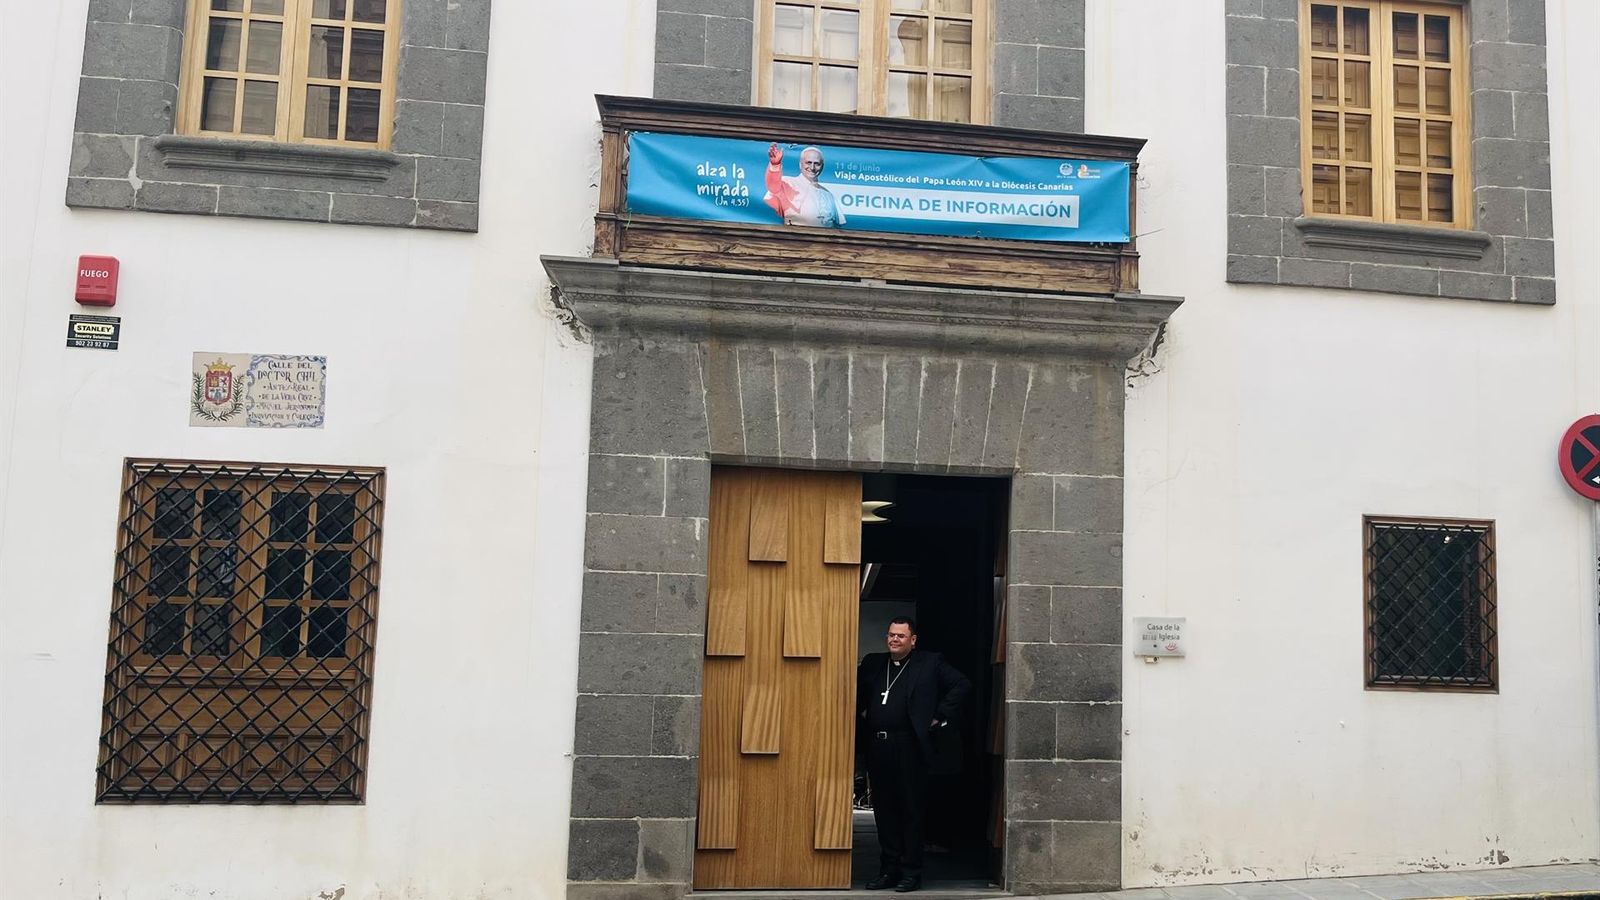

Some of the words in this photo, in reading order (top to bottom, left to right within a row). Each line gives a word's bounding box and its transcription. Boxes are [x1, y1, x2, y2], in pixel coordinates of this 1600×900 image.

[696, 160, 727, 178] alza
[732, 162, 745, 179] la
[835, 162, 844, 170] 11
[847, 162, 857, 171] de
[859, 163, 880, 172] junio
[834, 171, 857, 181] Viaje
[859, 172, 904, 184] Apostólico
[905, 175, 920, 184] del
[923, 177, 944, 187] Papa
[946, 178, 967, 187] León
[968, 179, 983, 188] XIV
[991, 180, 1000, 189] la
[1001, 181, 1036, 190] Diócesis
[1037, 183, 1074, 191] Canarias
[697, 179, 749, 197] mirada
[715, 195, 728, 206] (Jn
[840, 193, 914, 211] OFICINA
[918, 199, 942, 212] DE
[946, 199, 1071, 218] INFORMACIÓN
[80, 269, 109, 278] FUEGO
[76, 325, 112, 333] STANLEY
[268, 360, 293, 370] CALLE
[257, 370, 291, 382] DOCTOR
[1147, 623, 1163, 631] Casa
[1173, 623, 1180, 631] la
[1158, 633, 1180, 642] Iglesia
